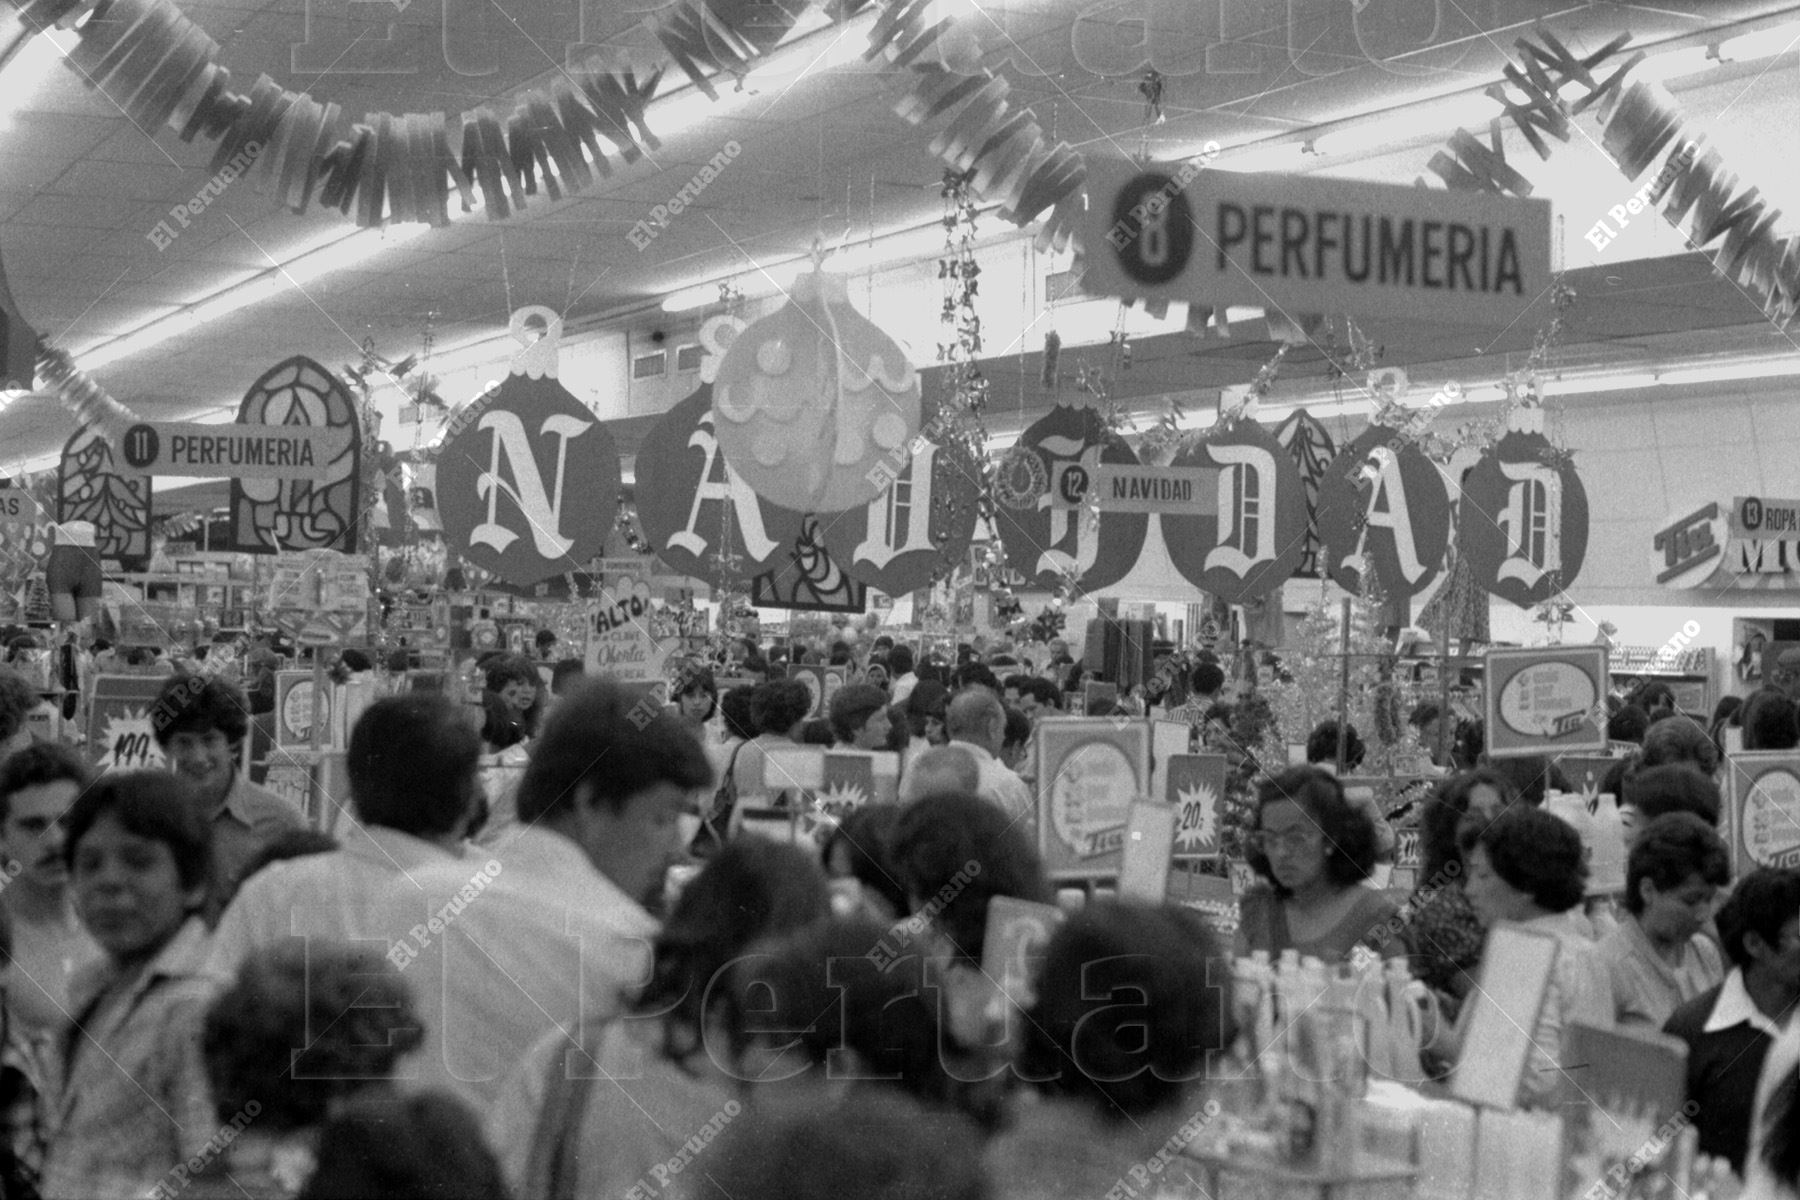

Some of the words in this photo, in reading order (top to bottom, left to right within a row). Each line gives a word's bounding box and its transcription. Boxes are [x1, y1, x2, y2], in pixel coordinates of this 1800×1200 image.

[1215, 203, 1524, 296] PERFUMERIA
[134, 431, 148, 460] 11
[171, 435, 314, 467] PERFUMERIA
[1067, 471, 1083, 498] 12
[1112, 476, 1192, 501] NAVIDAD
[1766, 508, 1797, 531] ROPA
